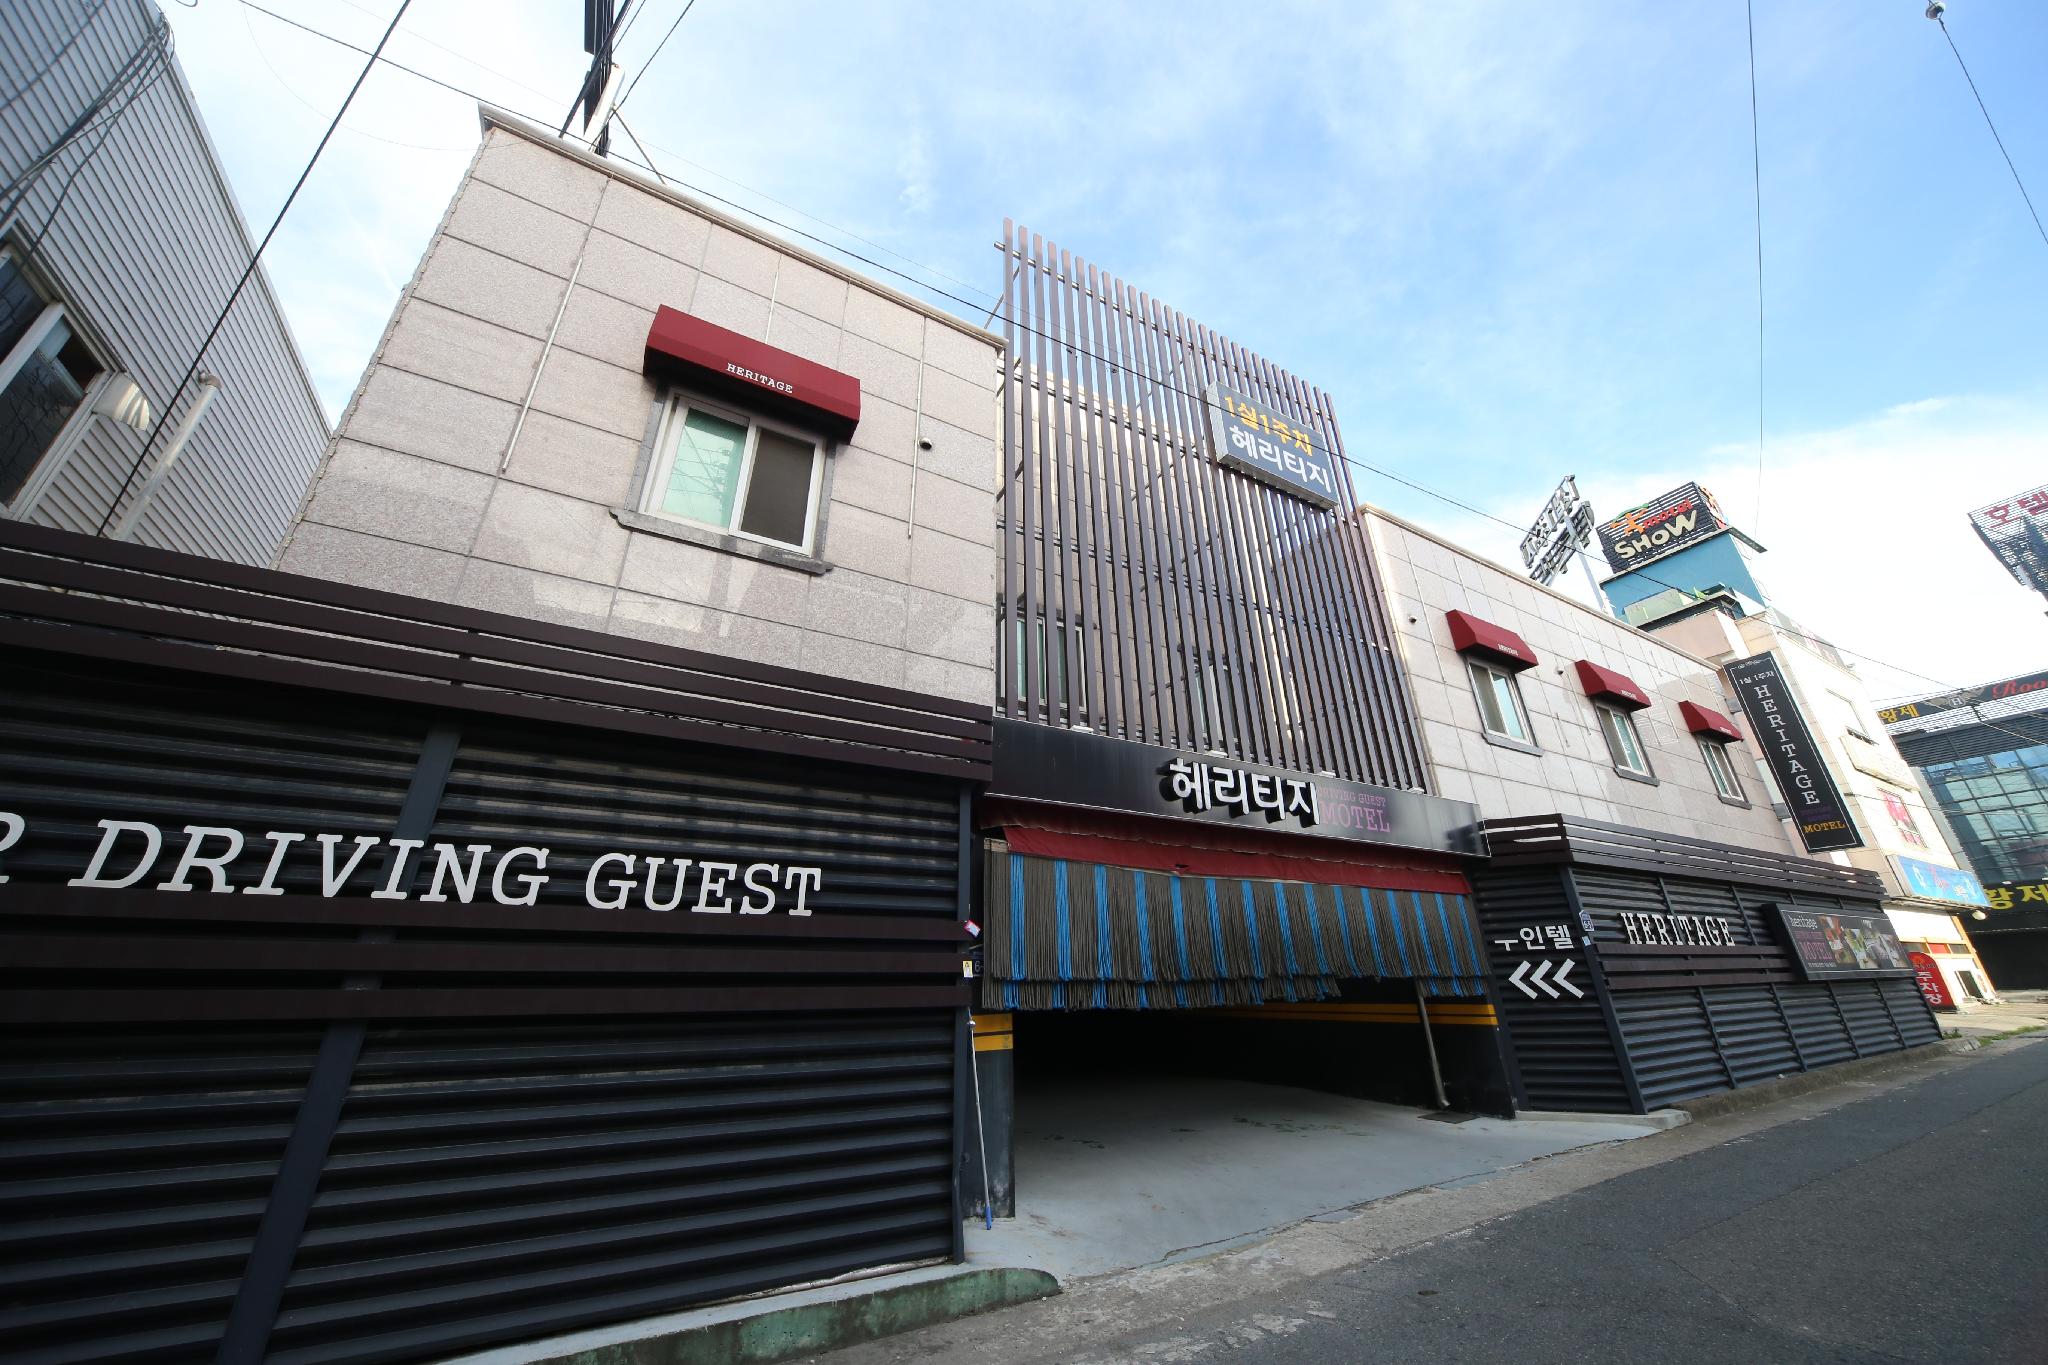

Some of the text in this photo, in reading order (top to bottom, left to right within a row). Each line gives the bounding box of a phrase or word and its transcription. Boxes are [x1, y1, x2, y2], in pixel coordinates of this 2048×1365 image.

[725, 362, 793, 394] HERITAGE
[1229, 424, 1332, 494] 헤리티지
[1642, 497, 1694, 529] motel
[1614, 509, 1697, 559] SHOW
[1753, 684, 1820, 805] HERITAGE
[1168, 757, 1320, 825] 헤리티지
[1358, 793, 1387, 808] GUEST
[1319, 800, 1391, 833] MOTEL
[1802, 819, 1846, 833] MOTEL
[67, 818, 549, 906] DRIVING
[585, 852, 822, 917] GUEST
[1620, 912, 1736, 946] HERITAGE
